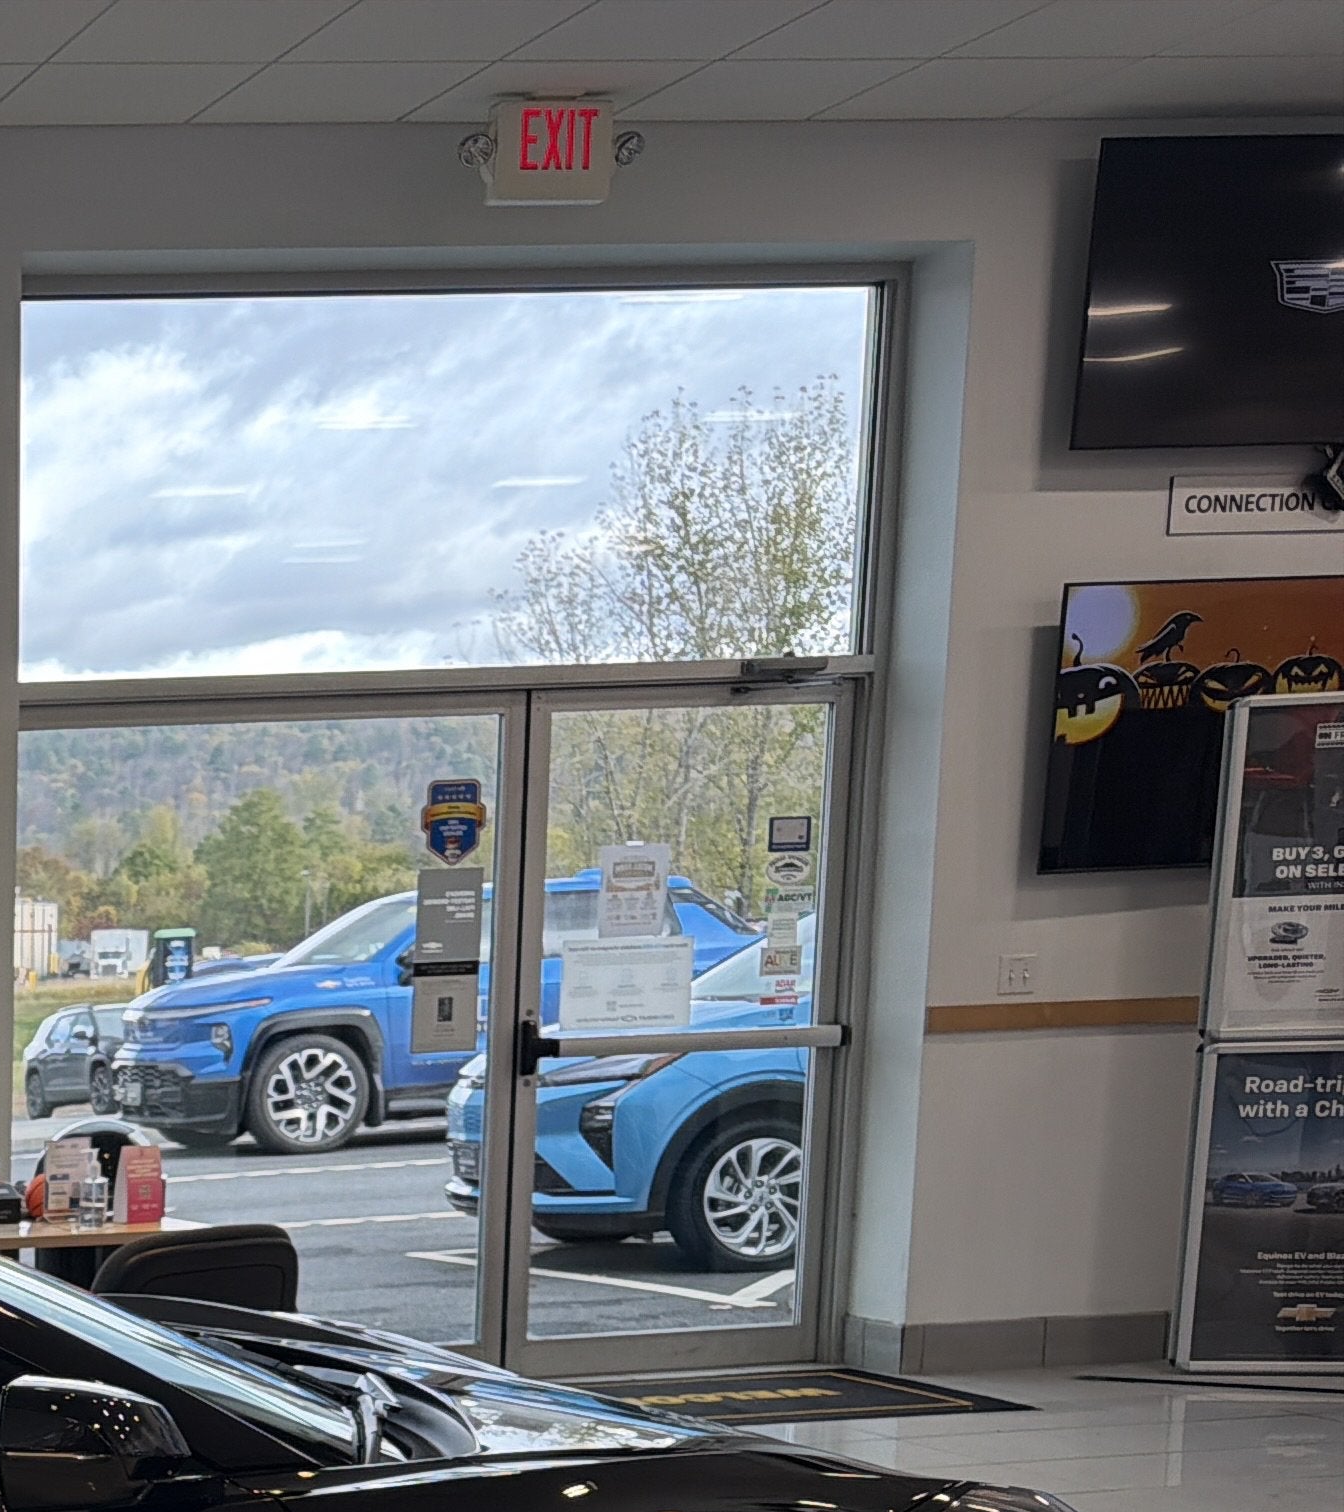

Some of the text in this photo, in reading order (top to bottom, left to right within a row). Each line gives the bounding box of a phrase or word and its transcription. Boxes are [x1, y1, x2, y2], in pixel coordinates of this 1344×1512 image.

[518, 107, 600, 171] EXIT
[1184, 492, 1316, 514] CONNECTION
[1272, 846, 1310, 861] BUY
[1312, 846, 1330, 862] 3,
[1275, 863, 1344, 878] ON SELE
[1268, 904, 1295, 913] MAKE
[1297, 904, 1322, 912] YOUR
[1244, 1074, 1344, 1096] Road-tri
[1238, 1099, 1344, 1118] with a Ch
[1257, 1251, 1293, 1260] Equinox
[1294, 1251, 1307, 1260] EV
[1307, 1251, 1325, 1259] and
